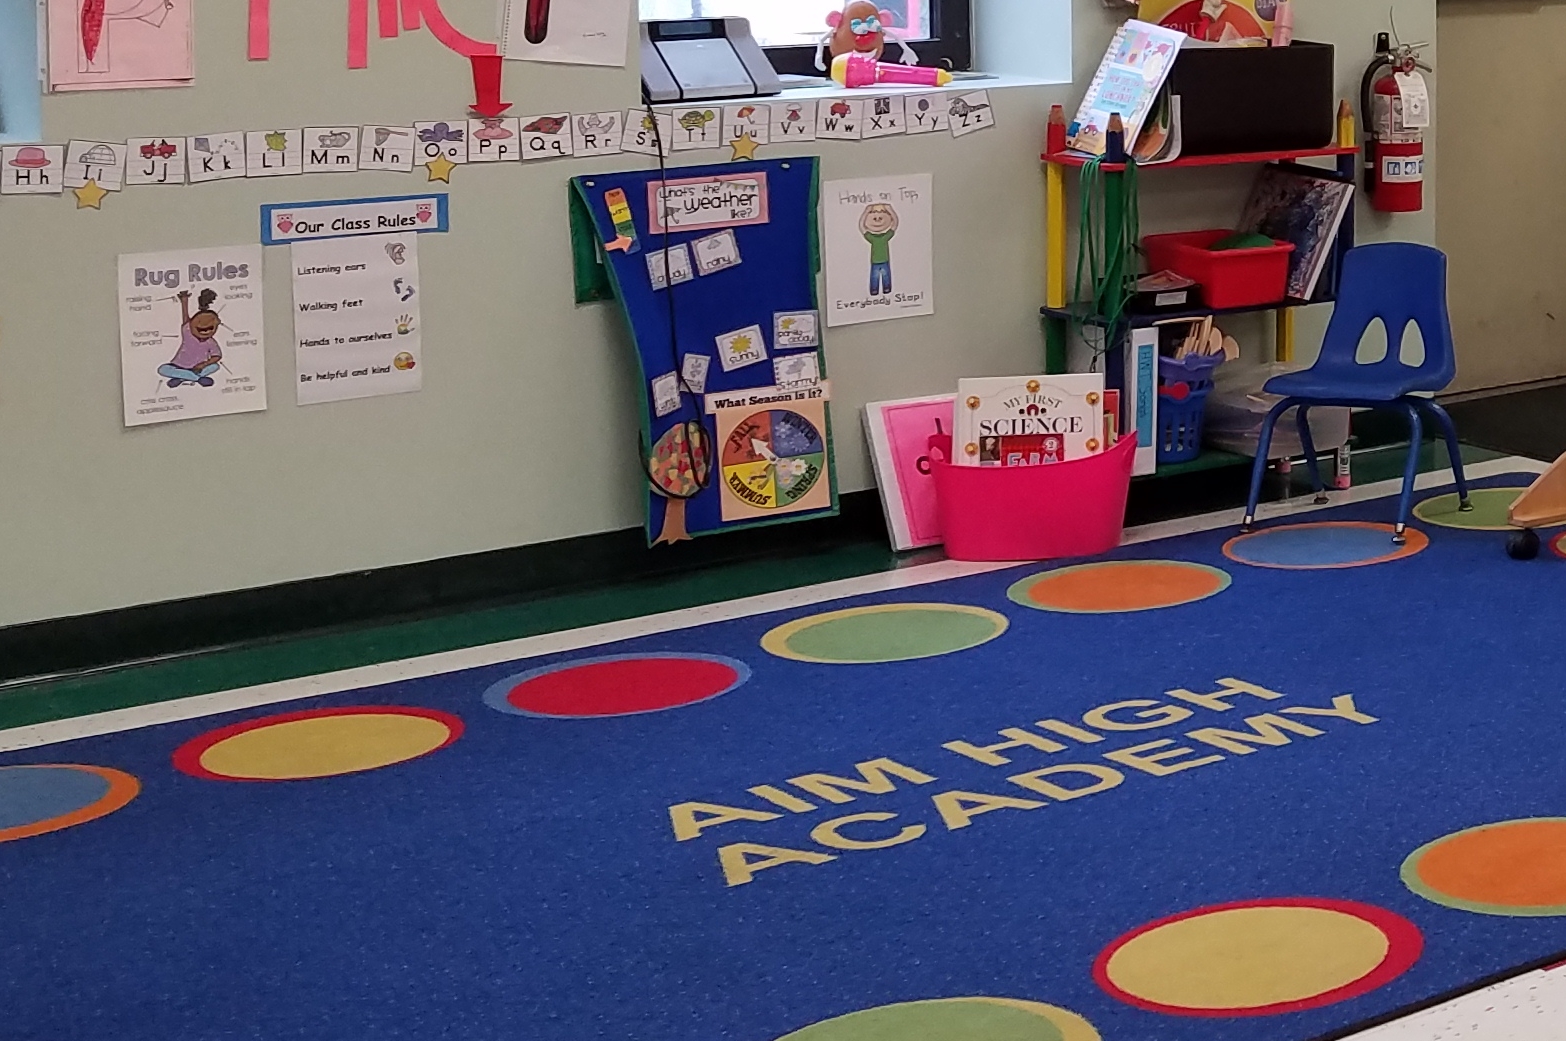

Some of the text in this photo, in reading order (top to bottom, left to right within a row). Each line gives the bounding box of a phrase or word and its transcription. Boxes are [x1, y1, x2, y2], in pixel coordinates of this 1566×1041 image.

[702, 185, 720, 195] the
[839, 188, 919, 203] Hands on Top
[684, 193, 757, 212] weather
[295, 214, 416, 235] Our Class Rules
[134, 262, 249, 288] Rug Rules
[297, 262, 366, 276] Listening ears
[299, 298, 363, 313] Walking feet
[836, 291, 924, 311] Everybody Stop!
[299, 331, 393, 348] Hands to ourselves
[729, 348, 760, 365] sunny
[300, 364, 391, 383] Be helpful and kind
[714, 394, 792, 409] What Season
[1003, 394, 1063, 411] MY FIRST
[980, 416, 1083, 435] SCIENCE
[730, 421, 760, 453] FALL
[729, 471, 773, 506] SUMMER
[785, 464, 818, 500] SPRING
[667, 677, 1285, 842] AIM HIGH
[717, 693, 1380, 887] ACADEMY
